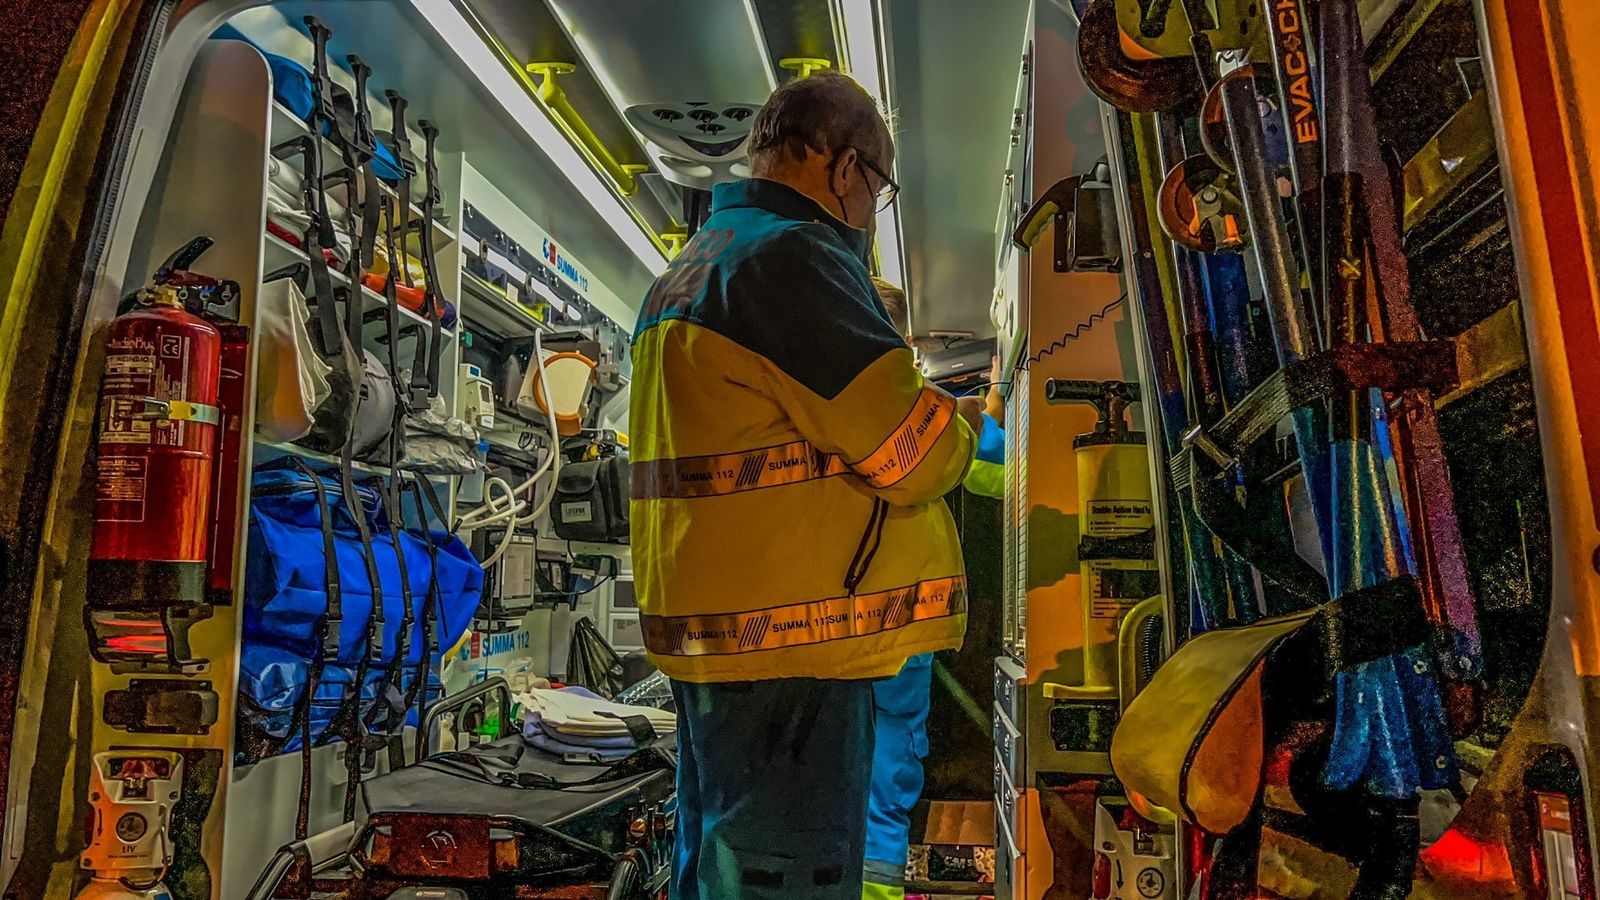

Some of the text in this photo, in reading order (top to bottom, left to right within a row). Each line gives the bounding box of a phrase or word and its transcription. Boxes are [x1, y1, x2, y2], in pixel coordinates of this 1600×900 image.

[1285, 51, 1318, 144] EVAC
[557, 254, 588, 292] SUMMA 112
[163, 344, 179, 355] CE
[916, 403, 940, 437] SUMMA
[768, 457, 807, 471] SUMMA
[879, 458, 897, 473] 112
[680, 471, 714, 483] SUMMA
[716, 469, 735, 480] 112
[929, 592, 945, 603] 112
[772, 616, 812, 633] SUMMA
[866, 608, 882, 619] 112
[687, 628, 738, 641] SUMMA 112
[482, 633, 515, 658] SUMMA
[517, 630, 530, 649] 112
